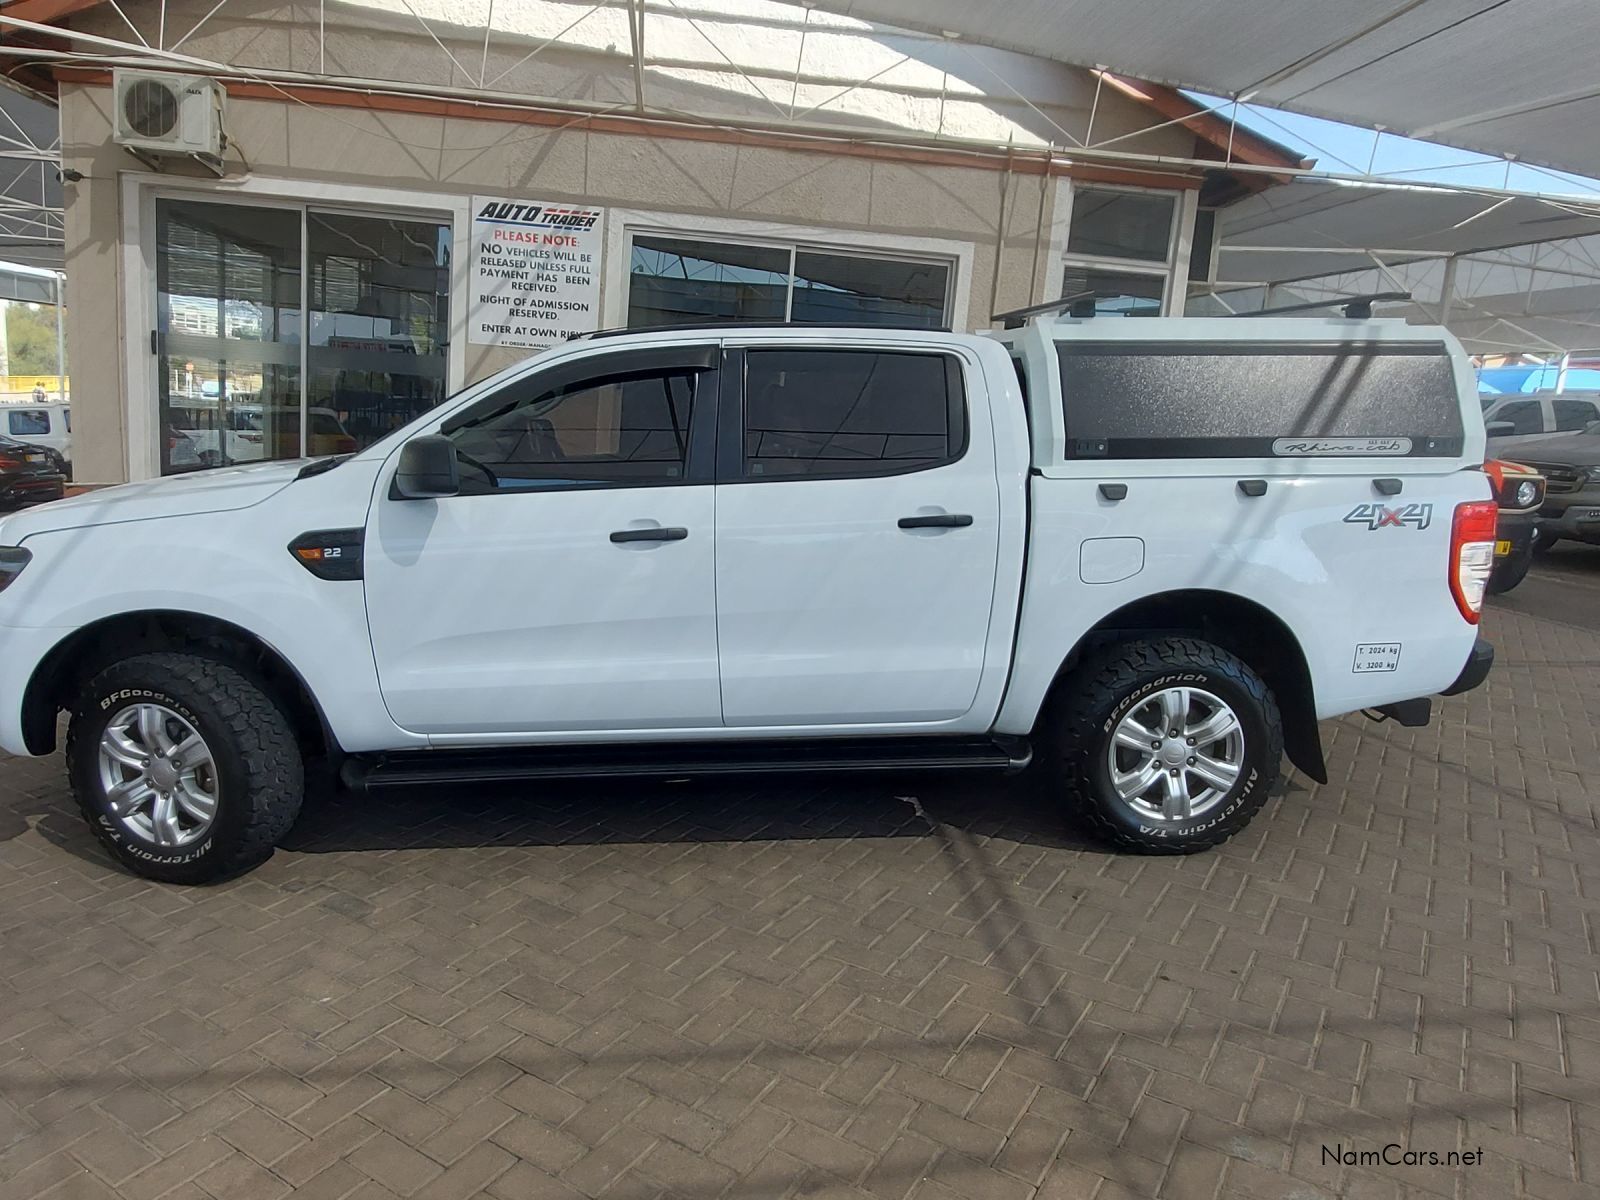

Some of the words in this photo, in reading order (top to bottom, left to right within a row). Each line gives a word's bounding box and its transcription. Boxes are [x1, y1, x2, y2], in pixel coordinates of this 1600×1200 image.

[479, 202, 542, 222] AUTO
[541, 211, 600, 228] TRADER
[494, 229, 539, 243] PLEASE
[481, 242, 502, 255] NO
[506, 247, 550, 259] VEHICLES
[553, 251, 577, 262] WILL
[580, 253, 592, 263] BE
[480, 256, 527, 269] RELEASED
[529, 262, 566, 273] UNLESS
[569, 264, 592, 275] FULL
[480, 268, 529, 281] PAYMENT
[536, 272, 558, 283] HAS
[565, 275, 590, 286] BEEN
[479, 294, 511, 306] RIGHT
[513, 297, 527, 307] OF
[529, 299, 589, 312] ADMISSION
[481, 323, 515, 335] ENTER
[514, 326, 527, 336] AT
[529, 327, 558, 338] OWN
[1368, 647, 1386, 655] 2024
[1389, 647, 1398, 655] kg
[1366, 661, 1384, 669] 3200
[1386, 662, 1396, 670] kg
[99, 688, 200, 727] BFGoodrich
[1103, 672, 1209, 733] BFGoodrich
[98, 813, 122, 843] T/A
[1138, 824, 1168, 838] T/A
